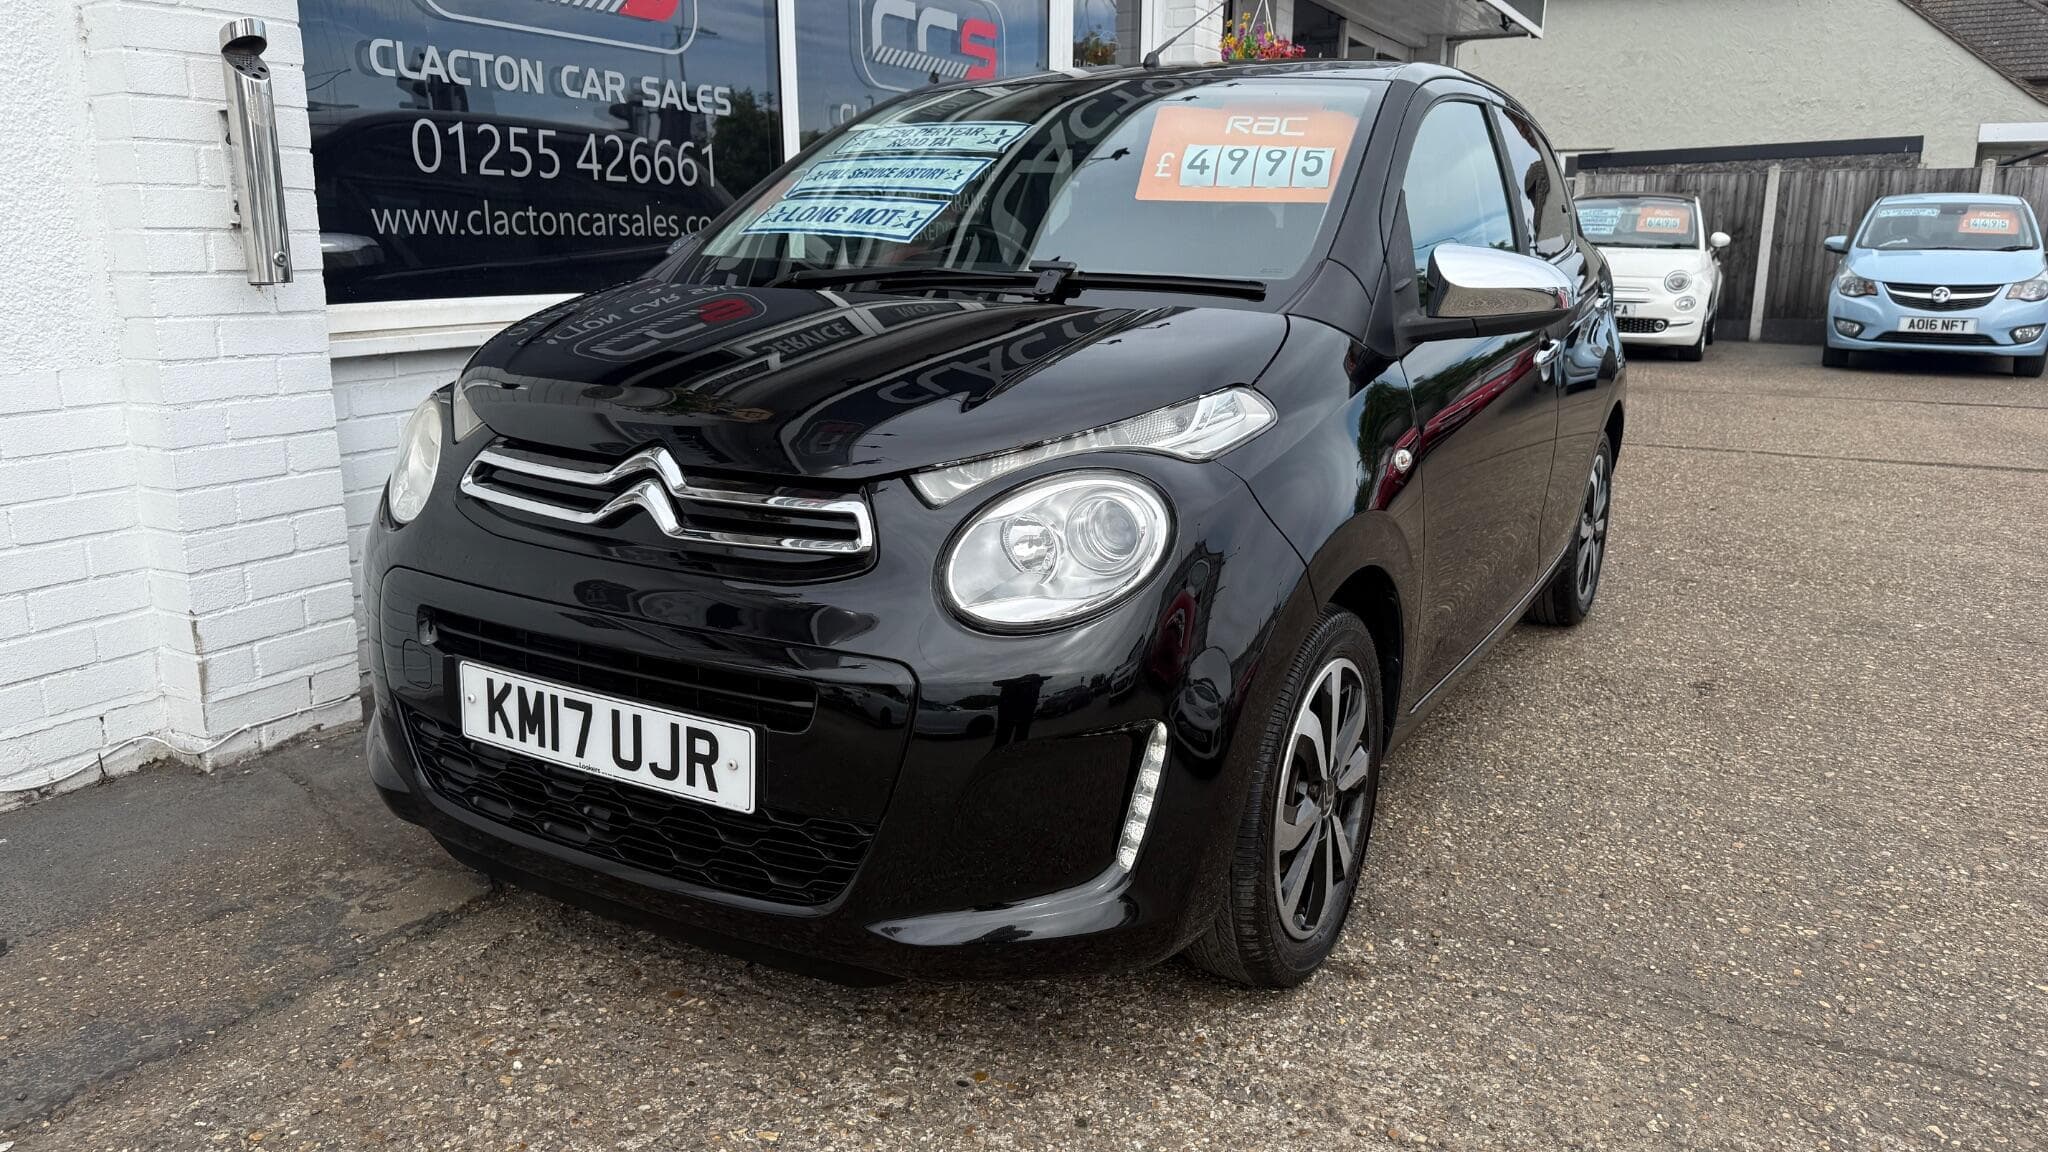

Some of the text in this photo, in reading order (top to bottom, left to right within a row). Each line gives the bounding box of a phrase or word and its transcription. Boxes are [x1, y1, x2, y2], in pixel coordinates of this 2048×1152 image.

[368, 38, 733, 117] CLACTON CAR SALES
[913, 127, 944, 137] PER
[942, 126, 986, 137] YEAR
[927, 137, 958, 148] TAX
[411, 118, 717, 188] 01255 426661
[847, 167, 899, 180] SERVICE
[897, 167, 949, 180] HISTORY
[784, 206, 905, 227] LONG MOT
[1907, 318, 1969, 331] AO16 NFT
[486, 677, 719, 793] KM17 UJR
